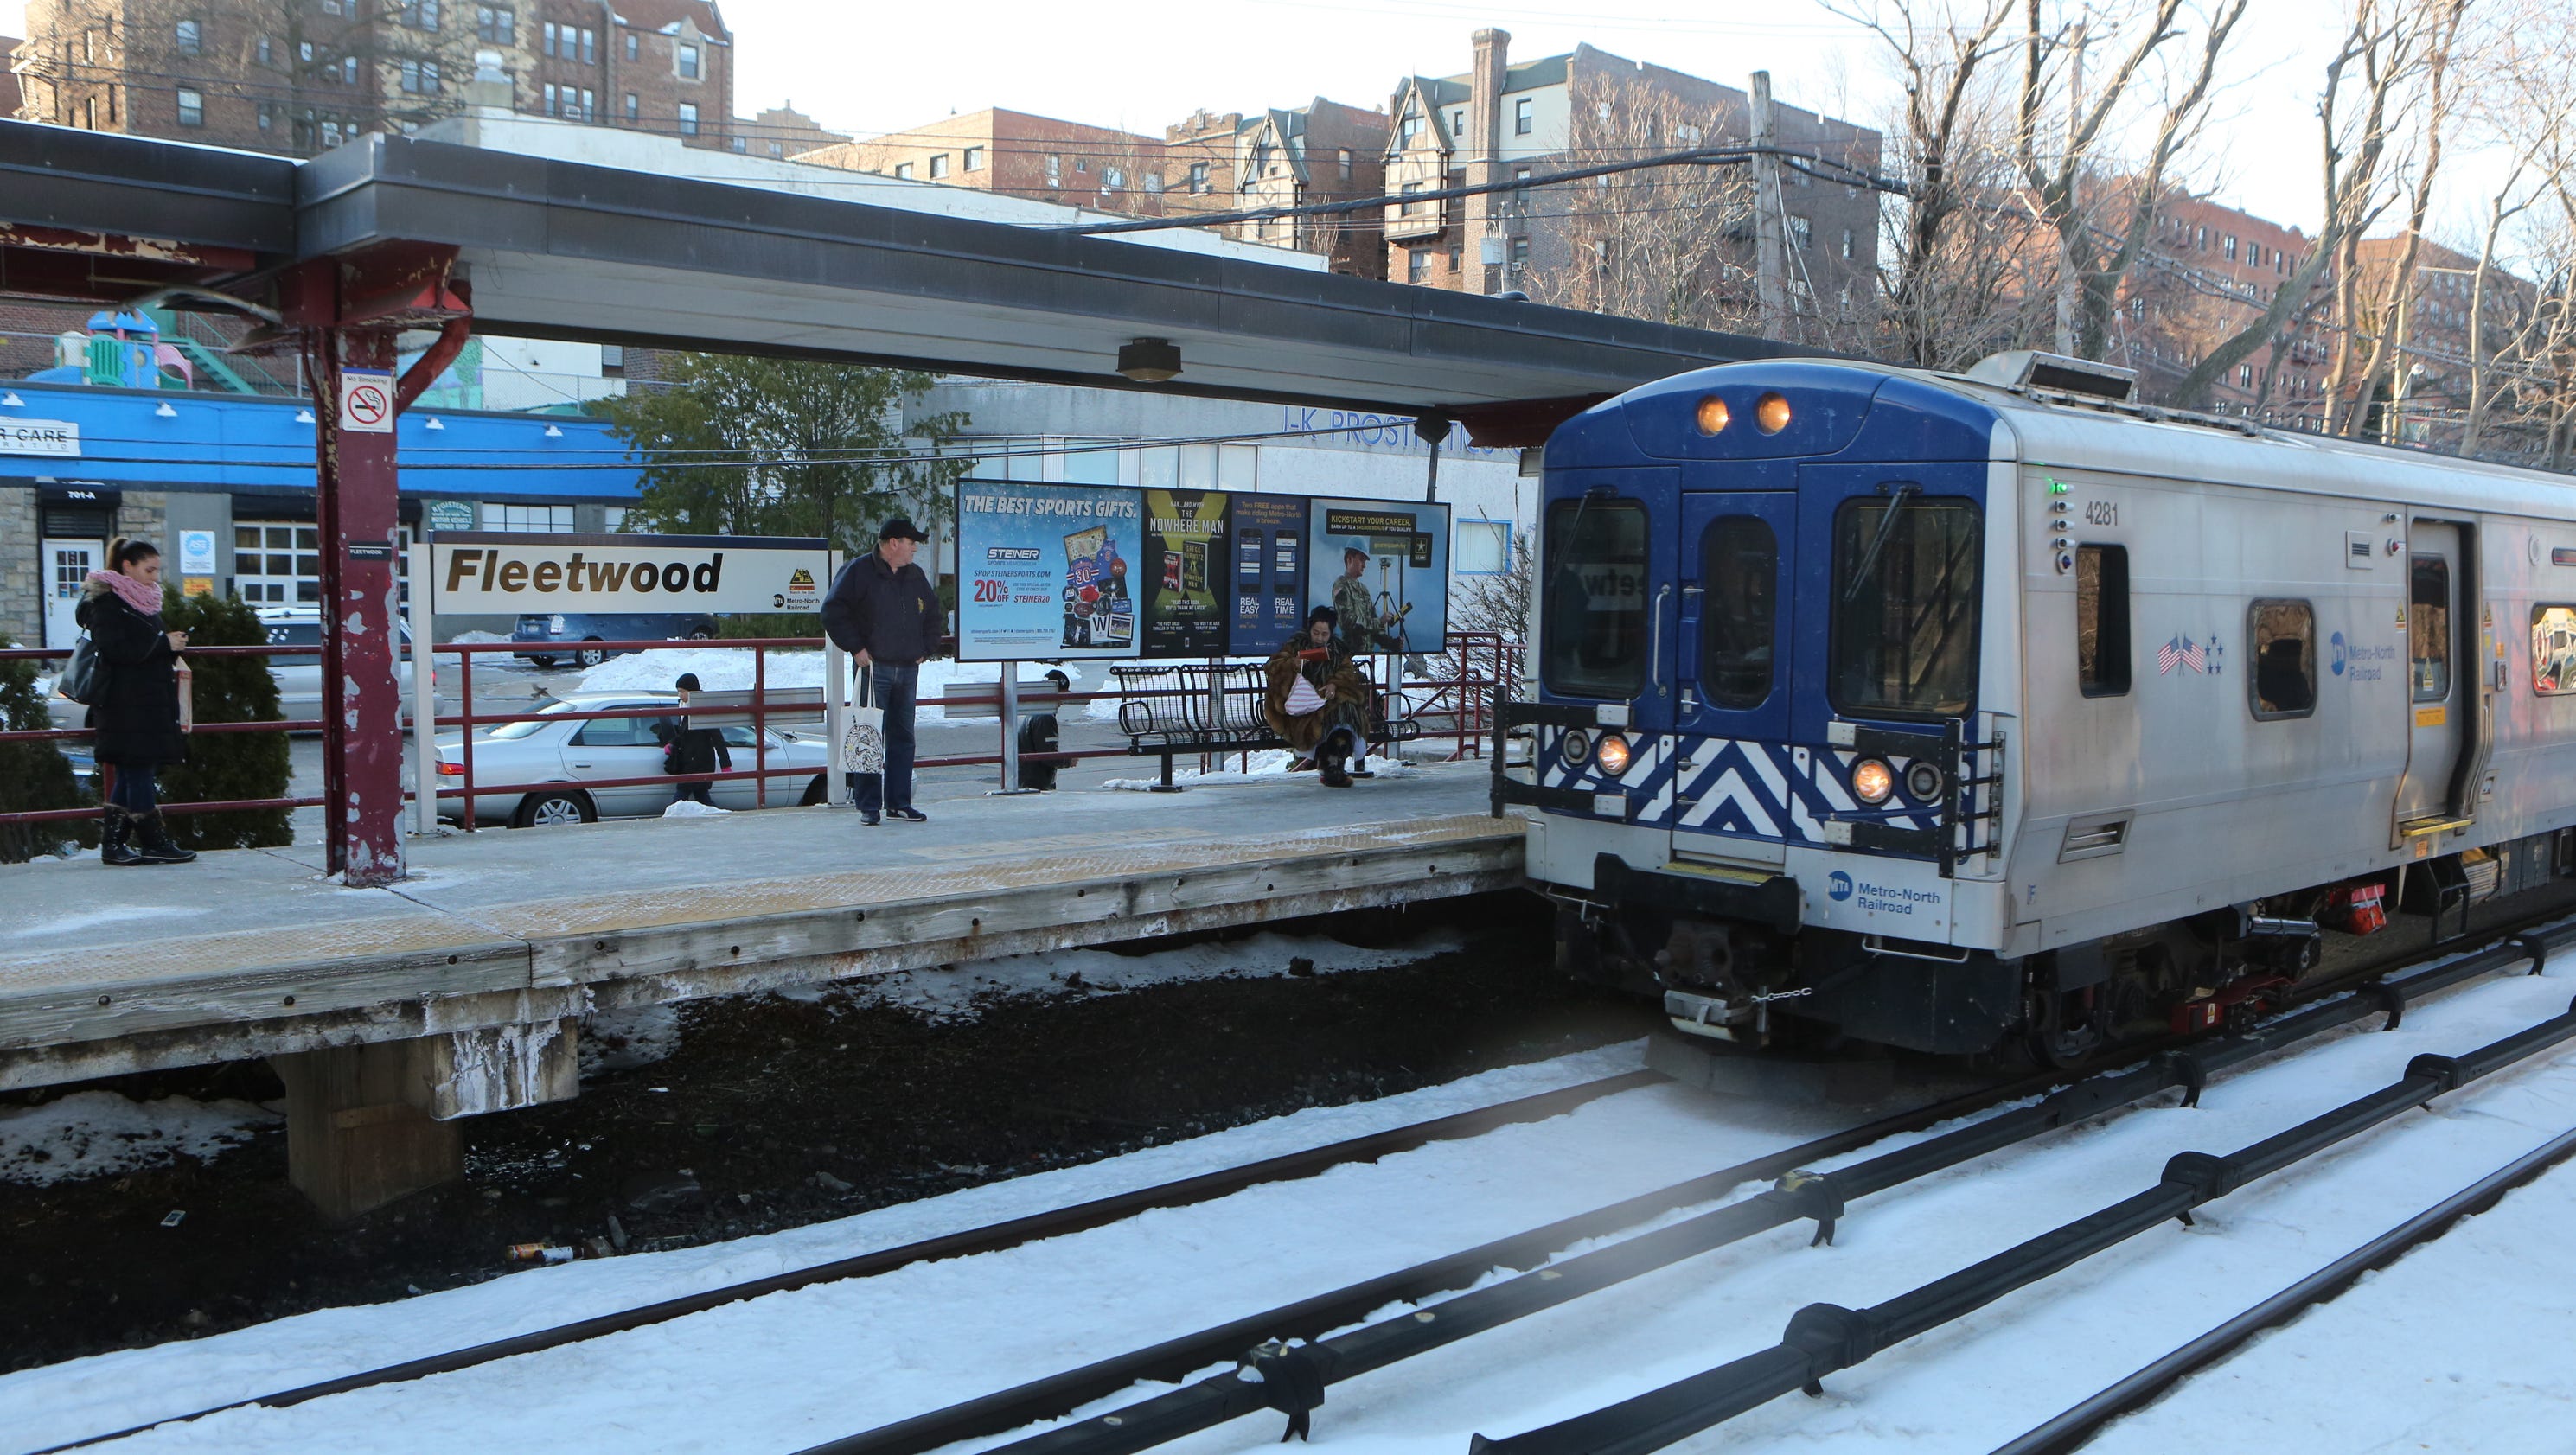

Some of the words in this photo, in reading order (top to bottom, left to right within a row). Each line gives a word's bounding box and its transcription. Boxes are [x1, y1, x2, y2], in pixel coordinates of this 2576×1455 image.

[358, 375, 387, 385] Smoking
[16, 429, 67, 443] CARE
[67, 490, 96, 499] 701-A
[431, 501, 472, 514] REGISTERED
[965, 495, 994, 513] THE
[996, 496, 1033, 514] BEST
[1035, 498, 1092, 517] SPORTS
[1094, 501, 1137, 518] GIFTS.
[2086, 501, 2118, 526] 4281
[1149, 518, 1199, 533] NOWHERE
[1202, 520, 1224, 533] MAN
[1331, 515, 1365, 524] KICKSTART
[1385, 518, 1411, 526] CAREER.
[988, 549, 1039, 559] STEINER
[445, 549, 723, 593] Fleetwood
[1076, 567, 1090, 584] 30
[1014, 595, 1050, 603] STEINER20
[1240, 597, 1259, 606] REAL
[1275, 597, 1294, 606] REAL
[1275, 606, 1294, 615] TIME
[1092, 616, 1107, 631] W
[2349, 645, 2395, 660] Metro-North
[2349, 666, 2381, 681] Railroad
[1828, 877, 1849, 893] MTA
[1859, 883, 1940, 903] Metro-North
[1858, 897, 1912, 915] Railroad
